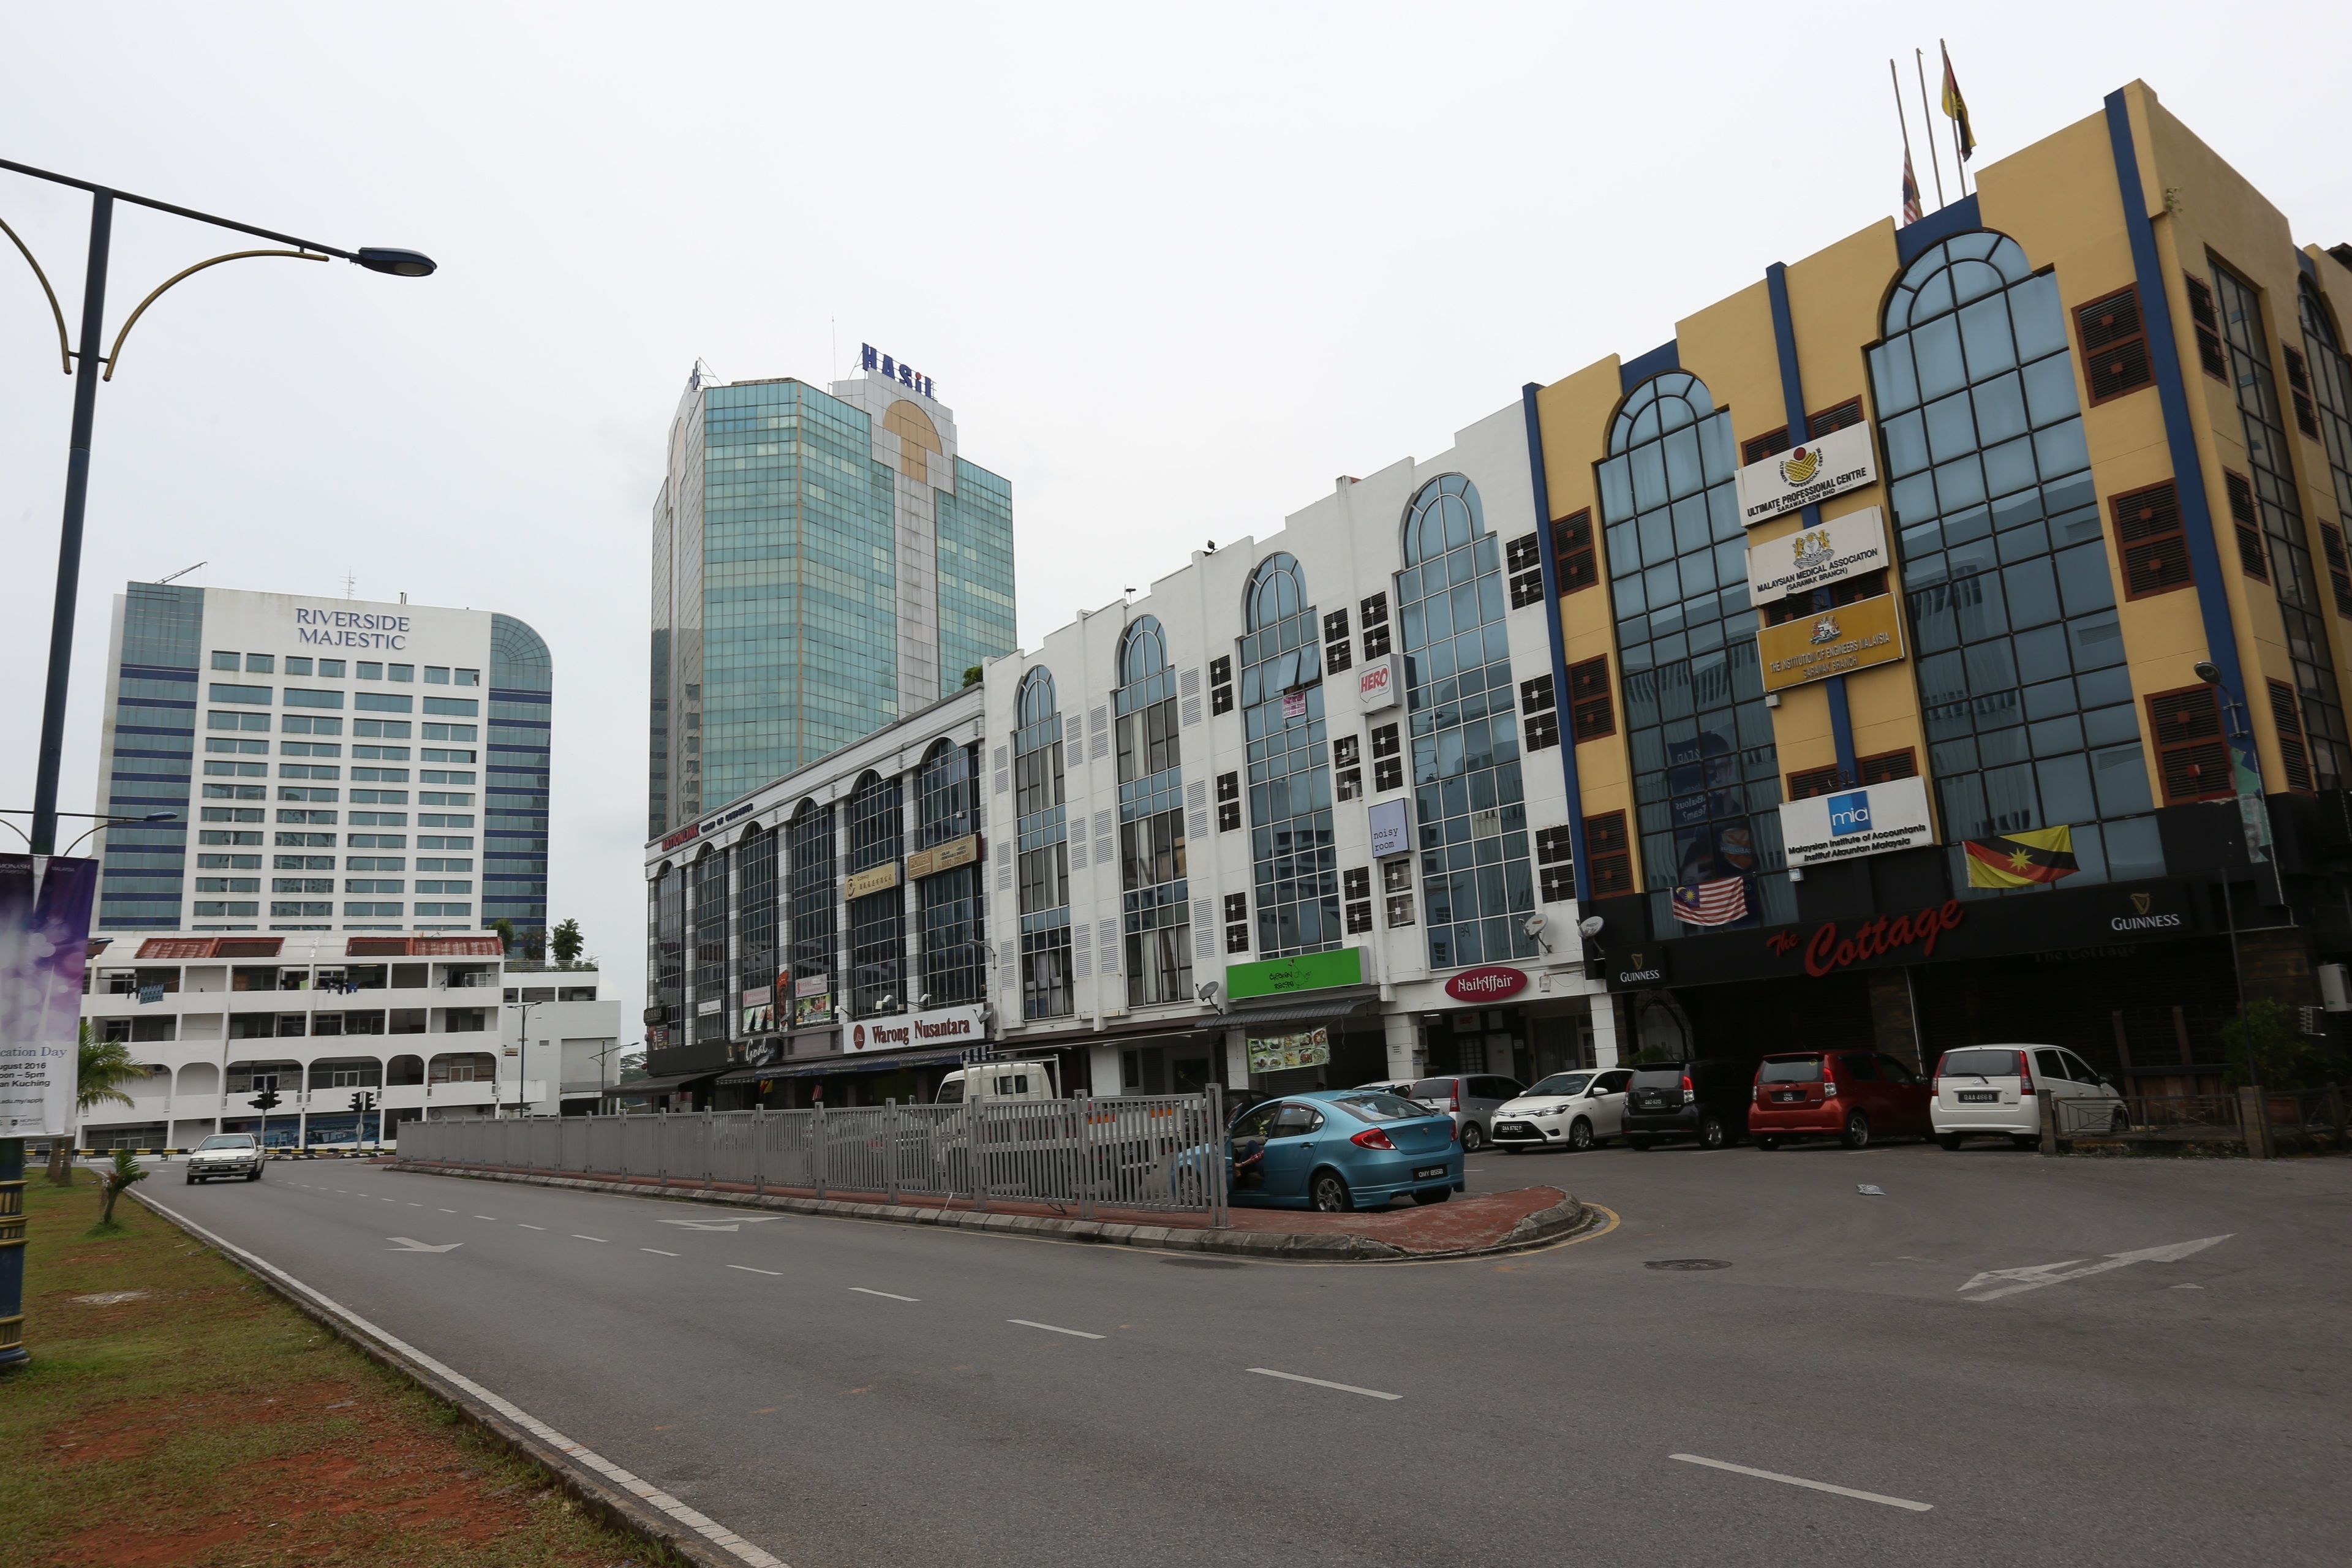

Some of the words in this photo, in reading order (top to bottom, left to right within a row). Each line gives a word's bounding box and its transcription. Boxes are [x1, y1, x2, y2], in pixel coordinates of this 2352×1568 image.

[1747, 499, 1781, 517] ULTIMATE
[1782, 480, 1836, 505] PROFESSIONAL
[1836, 467, 1867, 485] CENTRE
[1777, 499, 1807, 513] SARAWAK
[1822, 488, 1836, 497] BHD
[1757, 573, 1795, 592] MALAYSIAN
[1796, 565, 1827, 580] MEDICAL
[1829, 548, 1878, 570] ASSOCIATION
[1786, 578, 1818, 592] (SARAWAK
[1819, 567, 1848, 580] BRANCH)
[296, 608, 410, 632] RIVERSIDE
[298, 627, 406, 650] MAJESTIC
[1770, 661, 1781, 673] THE
[1782, 651, 1817, 670] INSTITUTION
[1817, 649, 1825, 661] OF
[1826, 640, 1859, 658] ENGINEERS
[1860, 632, 1891, 649] MALAYSIA
[1803, 662, 1831, 678] SARAWAK
[1832, 655, 1858, 671] BRANCH
[1361, 668, 1388, 693] HERO
[1832, 807, 1869, 826] mia
[662, 823, 700, 852] NATIONLINK
[1373, 827, 1398, 839] noisy
[1788, 842, 1828, 854] Malaysian
[1830, 834, 1861, 848] Institute
[1863, 833, 1871, 842] of
[1872, 824, 1926, 840] Accountants
[1374, 841, 1395, 851] room
[1804, 850, 1831, 862] Institut
[1831, 845, 1870, 858] Akauntan
[1872, 837, 1911, 851] Malaysia
[2111, 914, 2182, 931] GUINNESS
[1766, 930, 1800, 957] The
[1804, 899, 1964, 977] Cottage
[1458, 974, 1513, 992] NailAffair
[1620, 970, 1660, 982] GUINNESS
[872, 1025, 909, 1046] Warong
[914, 1018, 971, 1039] Nusantara
[0, 1047, 36, 1057] cation
[40, 1046, 67, 1058] Day
